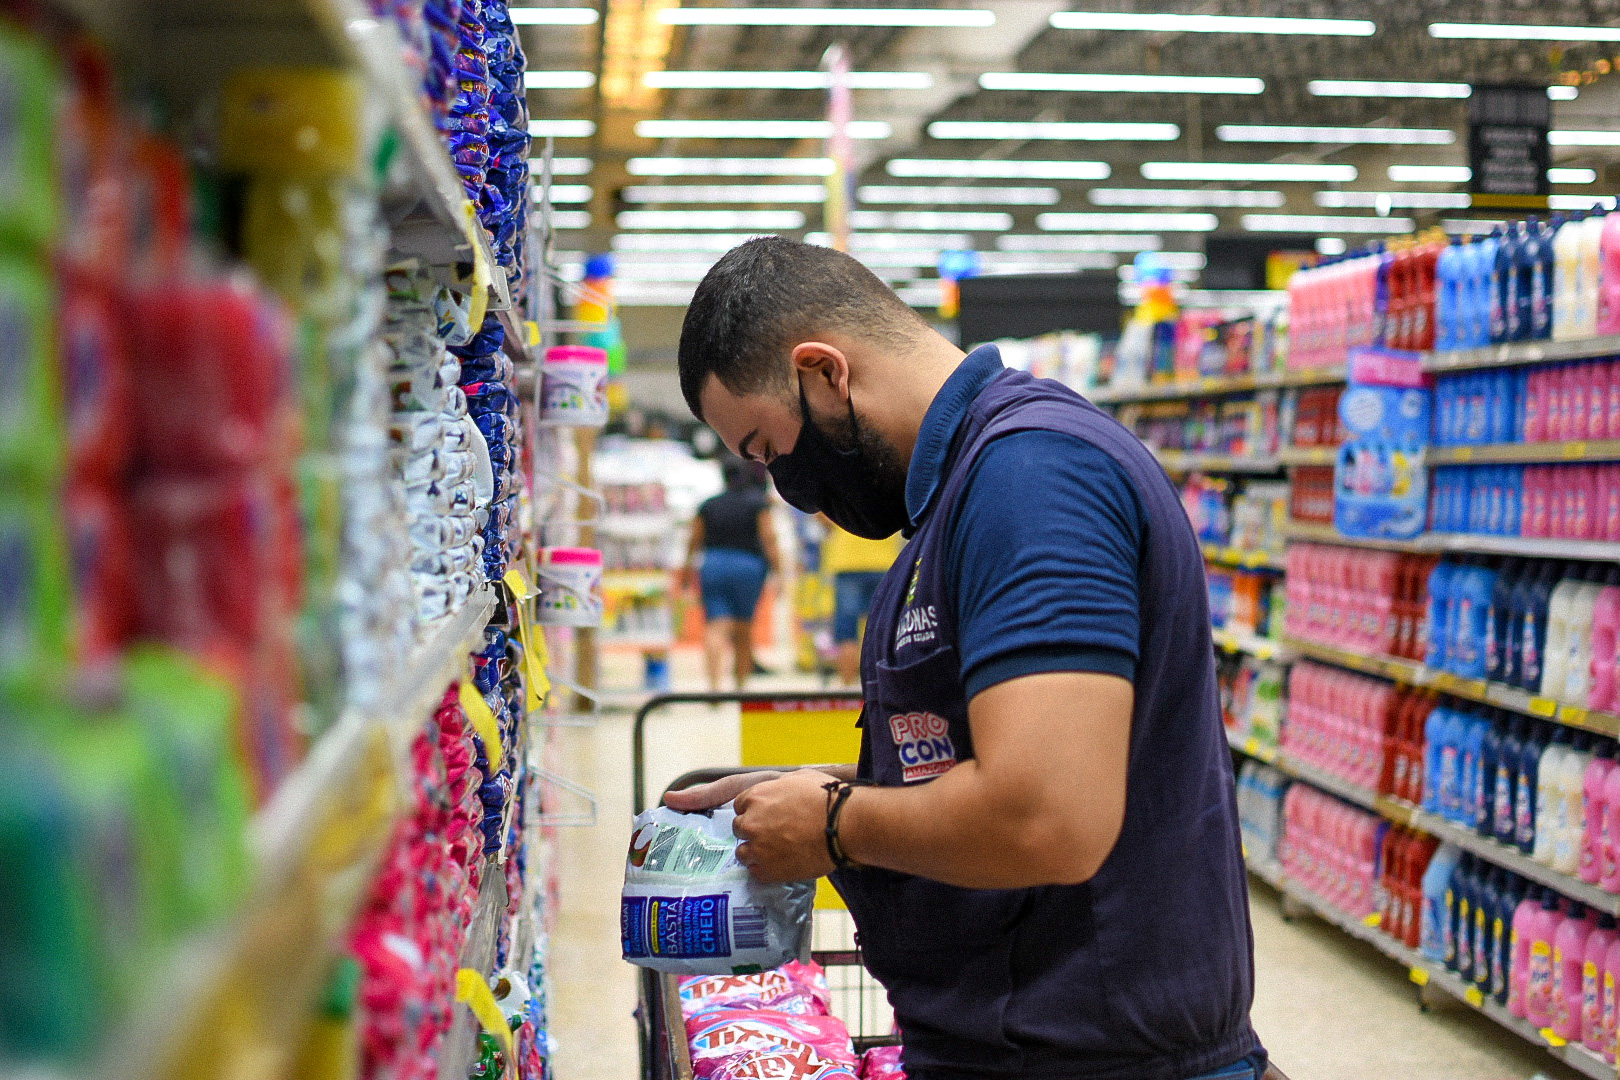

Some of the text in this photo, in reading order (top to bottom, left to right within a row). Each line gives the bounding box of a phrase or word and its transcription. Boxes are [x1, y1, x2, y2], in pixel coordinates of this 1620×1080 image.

[890, 712, 949, 743] PRO
[901, 736, 953, 765] CON
[666, 901, 679, 954] BASTA
[700, 899, 715, 953] CHEIO
